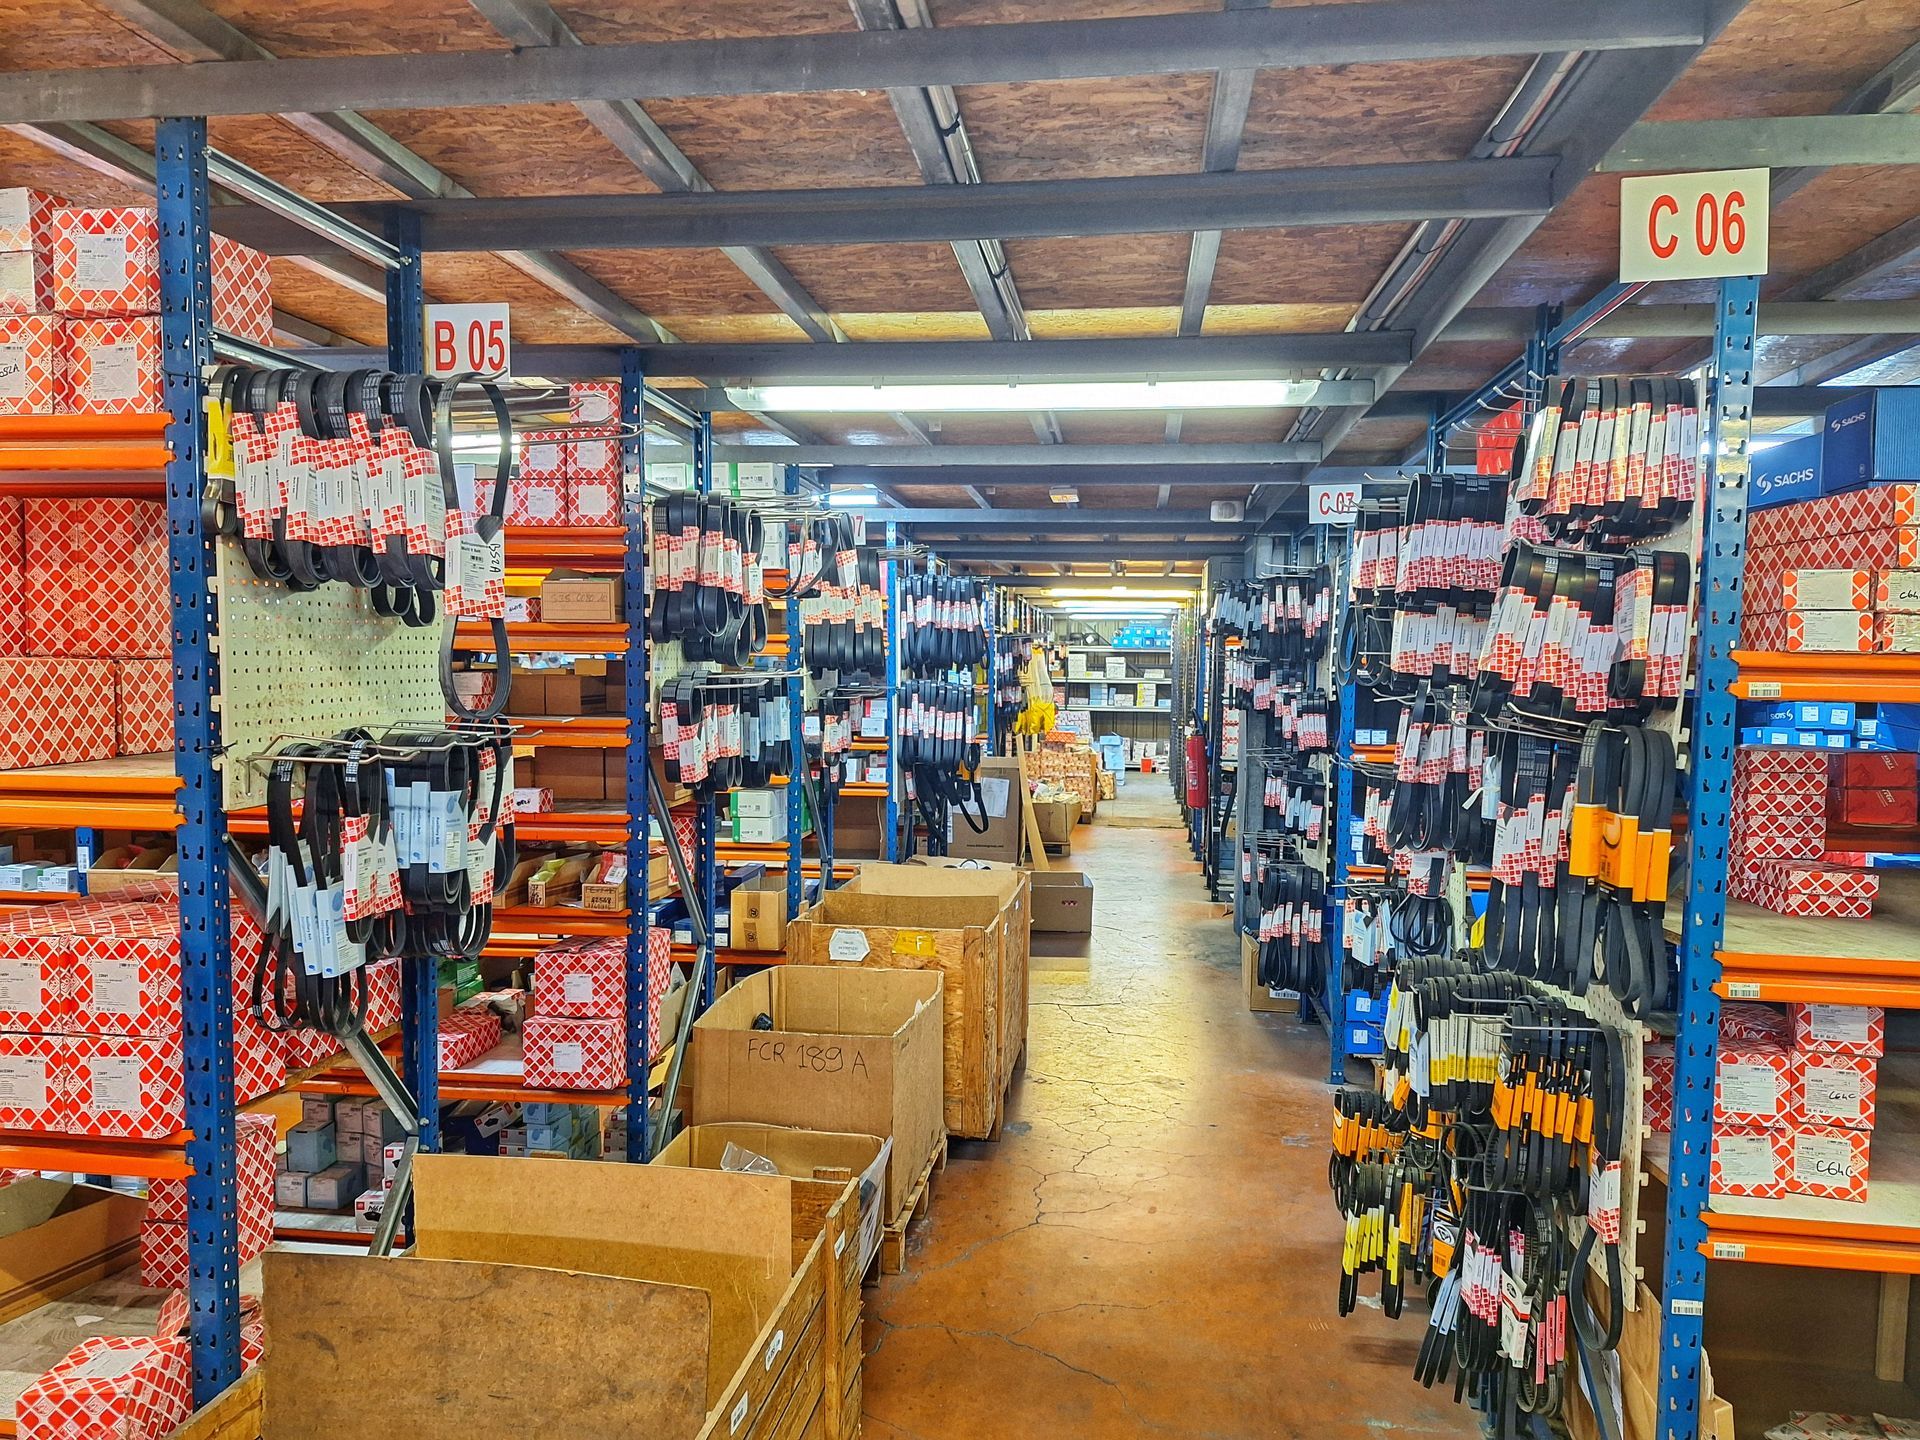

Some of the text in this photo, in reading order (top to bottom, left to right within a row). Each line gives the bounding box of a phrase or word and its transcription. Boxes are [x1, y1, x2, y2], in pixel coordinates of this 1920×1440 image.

[1648, 190, 1747, 259] C 06
[434, 320, 506, 371] B 05
[1841, 411, 1867, 427] SACHS
[1774, 468, 1814, 488] SACHS
[1319, 491, 1355, 515] C 07
[916, 935, 927, 951] F
[747, 1038, 869, 1079] FCR 189 A
